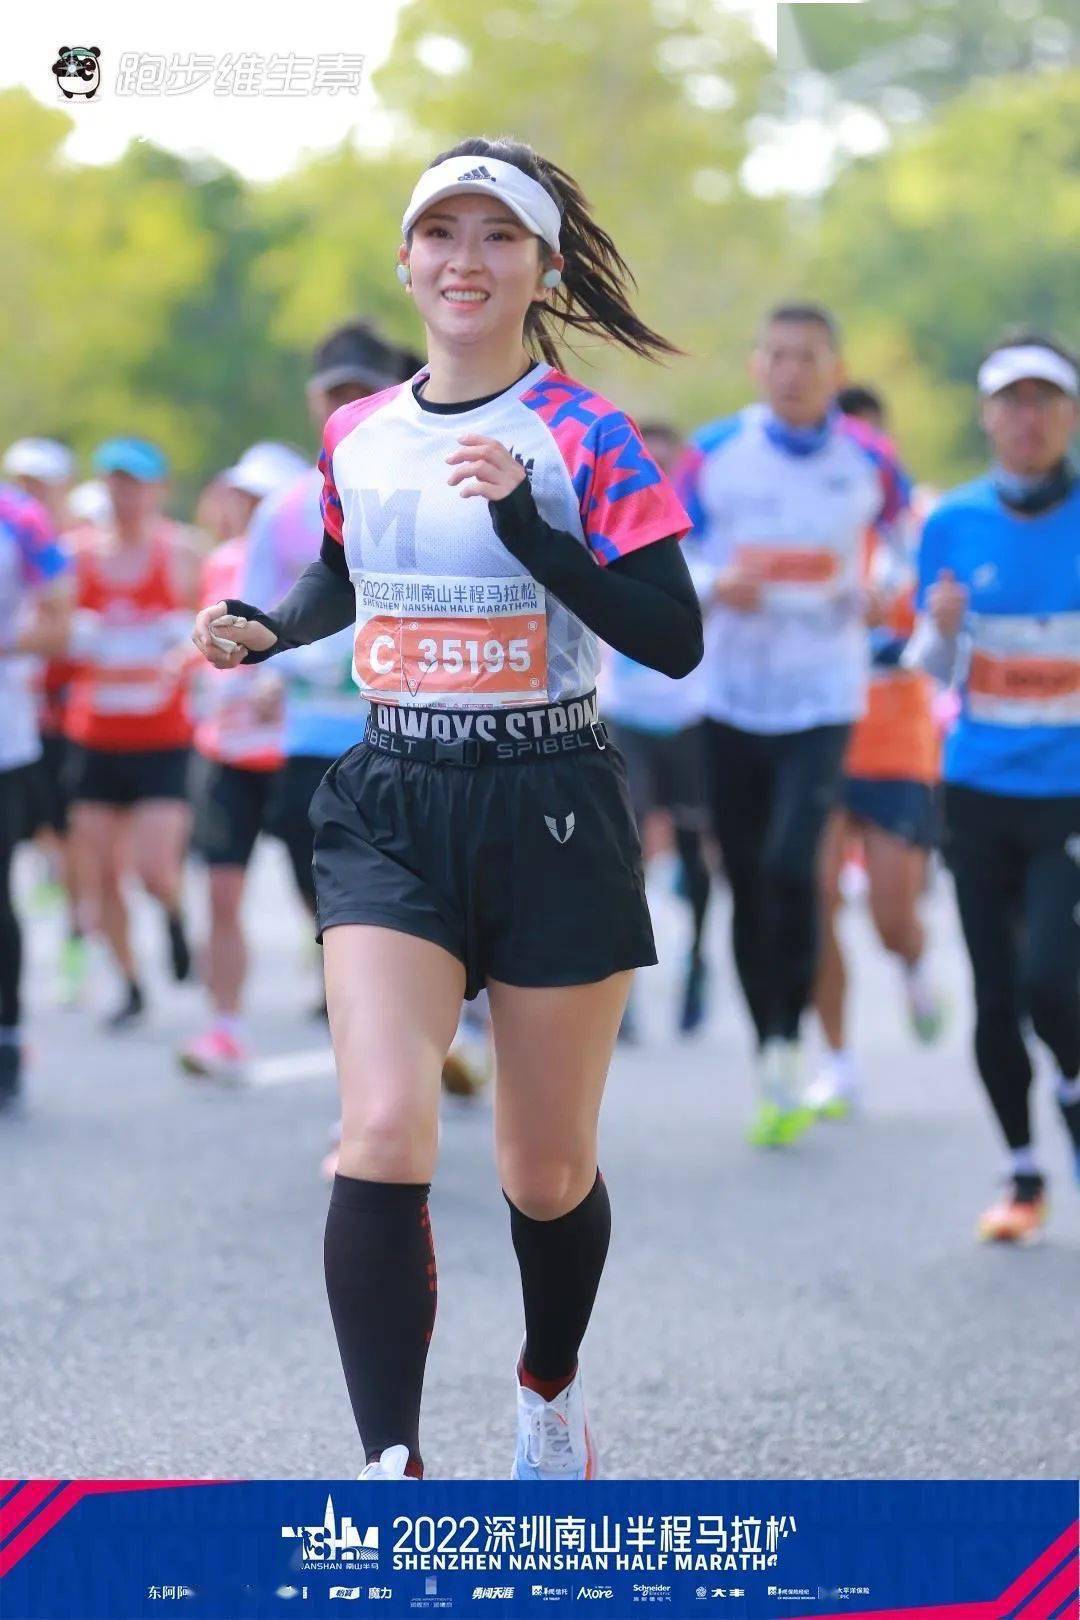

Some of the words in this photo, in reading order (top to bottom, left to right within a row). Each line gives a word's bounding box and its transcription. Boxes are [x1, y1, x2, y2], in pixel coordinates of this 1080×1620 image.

[361, 579, 537, 604] 2022深圳南山半程马拉松
[362, 598, 400, 611] SHENZHEN
[402, 600, 447, 613] NANSHAN
[450, 603, 474, 613] HALF
[477, 600, 537, 614] MARATHON
[369, 635, 395, 674] C
[417, 638, 531, 674] 35195
